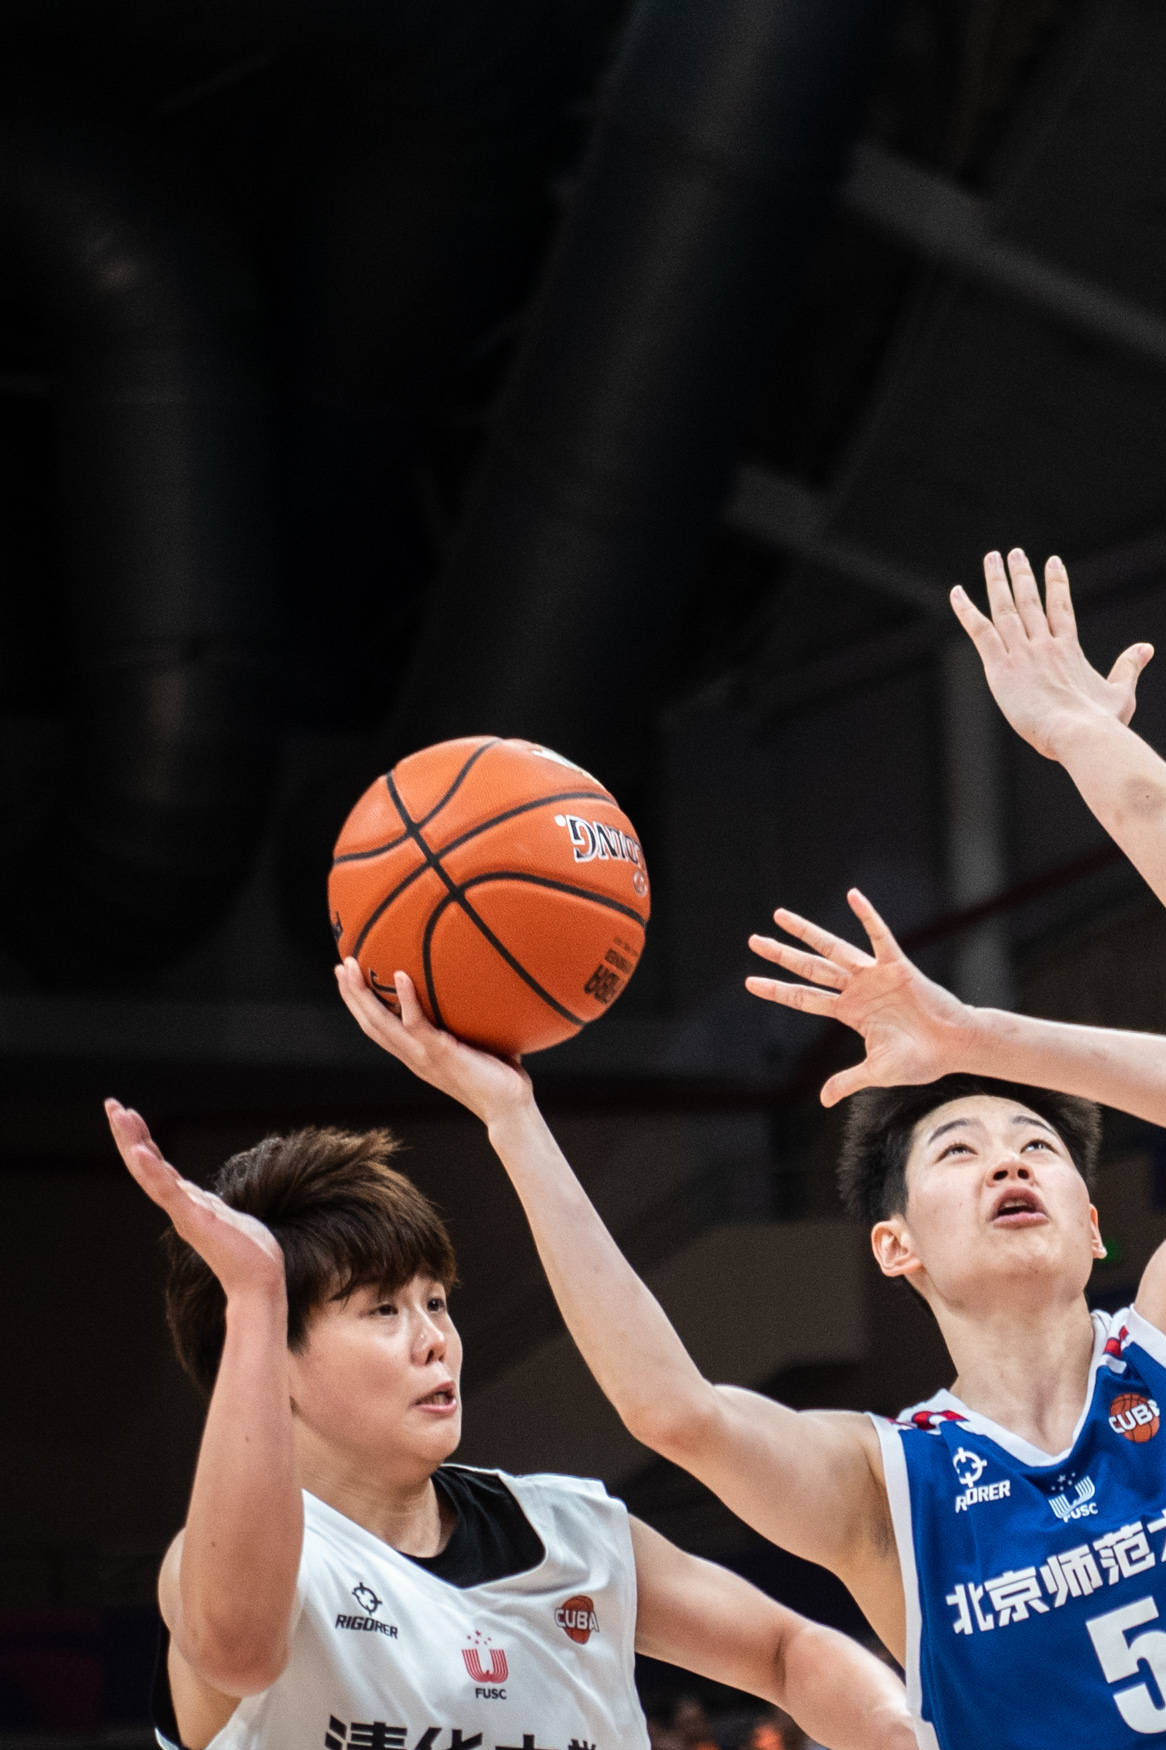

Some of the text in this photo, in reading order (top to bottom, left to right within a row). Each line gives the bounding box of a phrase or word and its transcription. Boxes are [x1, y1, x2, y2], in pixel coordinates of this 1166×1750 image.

[565, 814, 642, 868] DING
[335, 1613, 399, 1640] RIGORER
[553, 1607, 600, 1633] CUBA
[475, 1688, 507, 1700] FUSC
